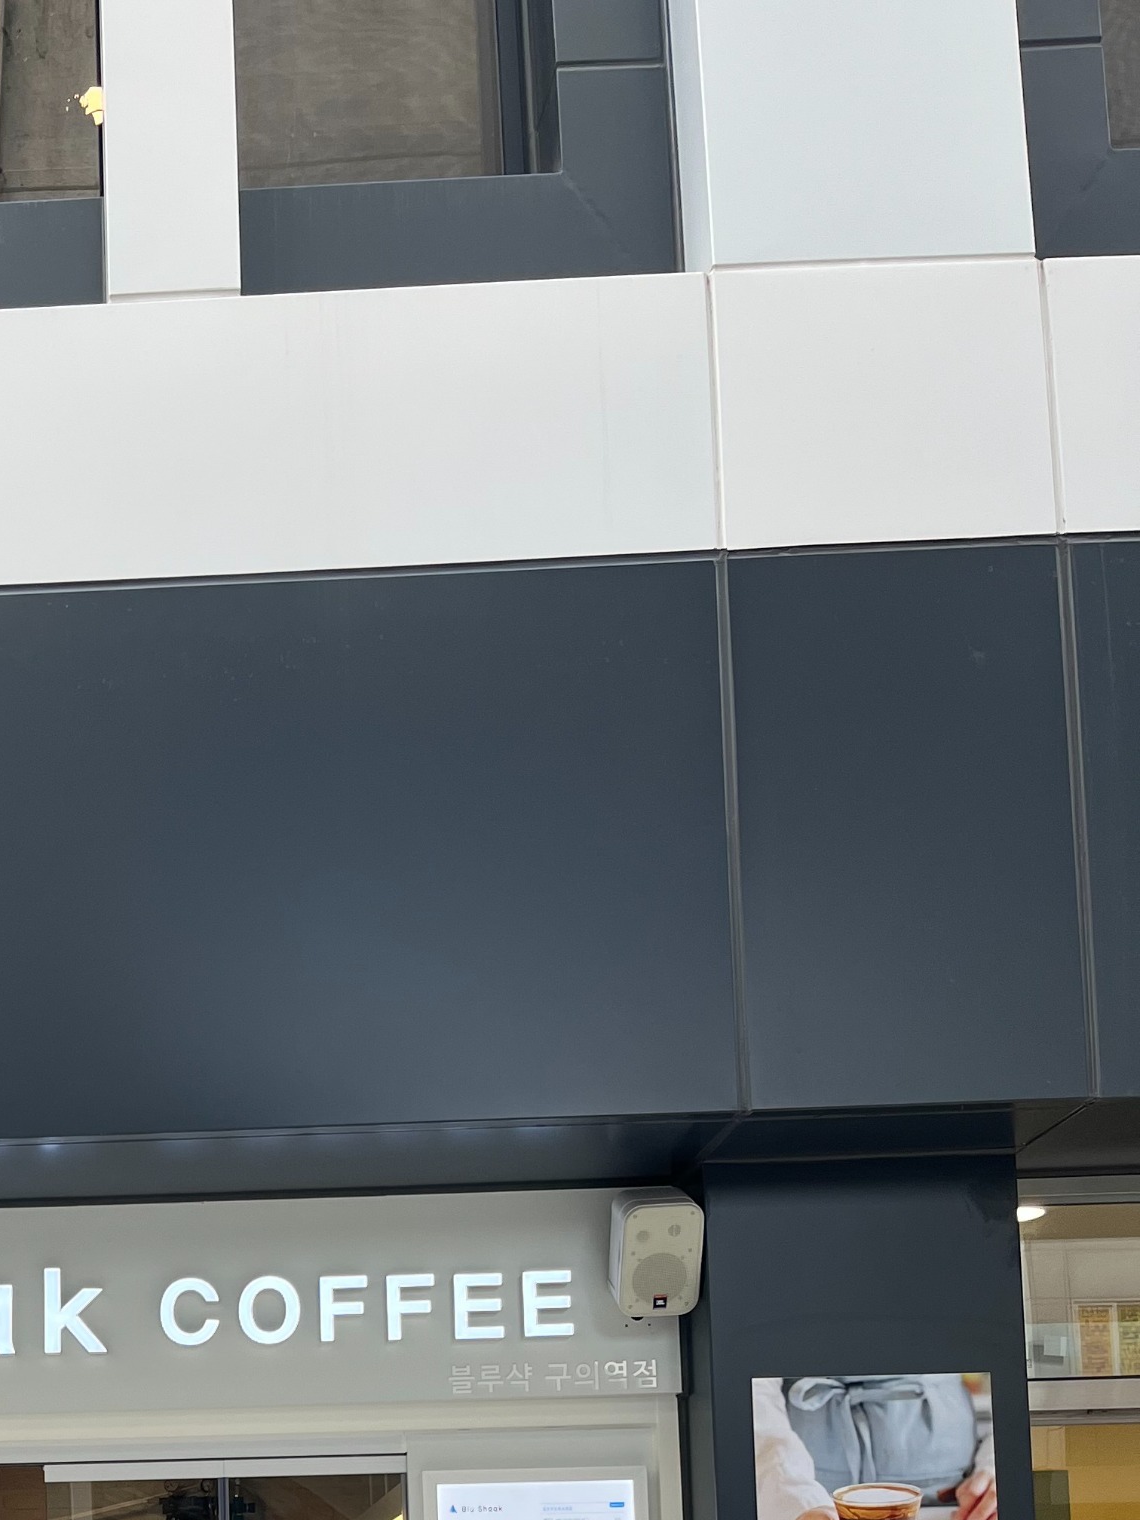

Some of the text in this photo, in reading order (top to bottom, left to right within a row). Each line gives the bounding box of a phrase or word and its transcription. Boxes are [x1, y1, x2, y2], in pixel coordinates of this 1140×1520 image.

[159, 1269, 576, 1347] COFFEE
[448, 1359, 658, 1394] 블루샥 구의역점
[461, 1505, 503, 1513] Blu Shaak
